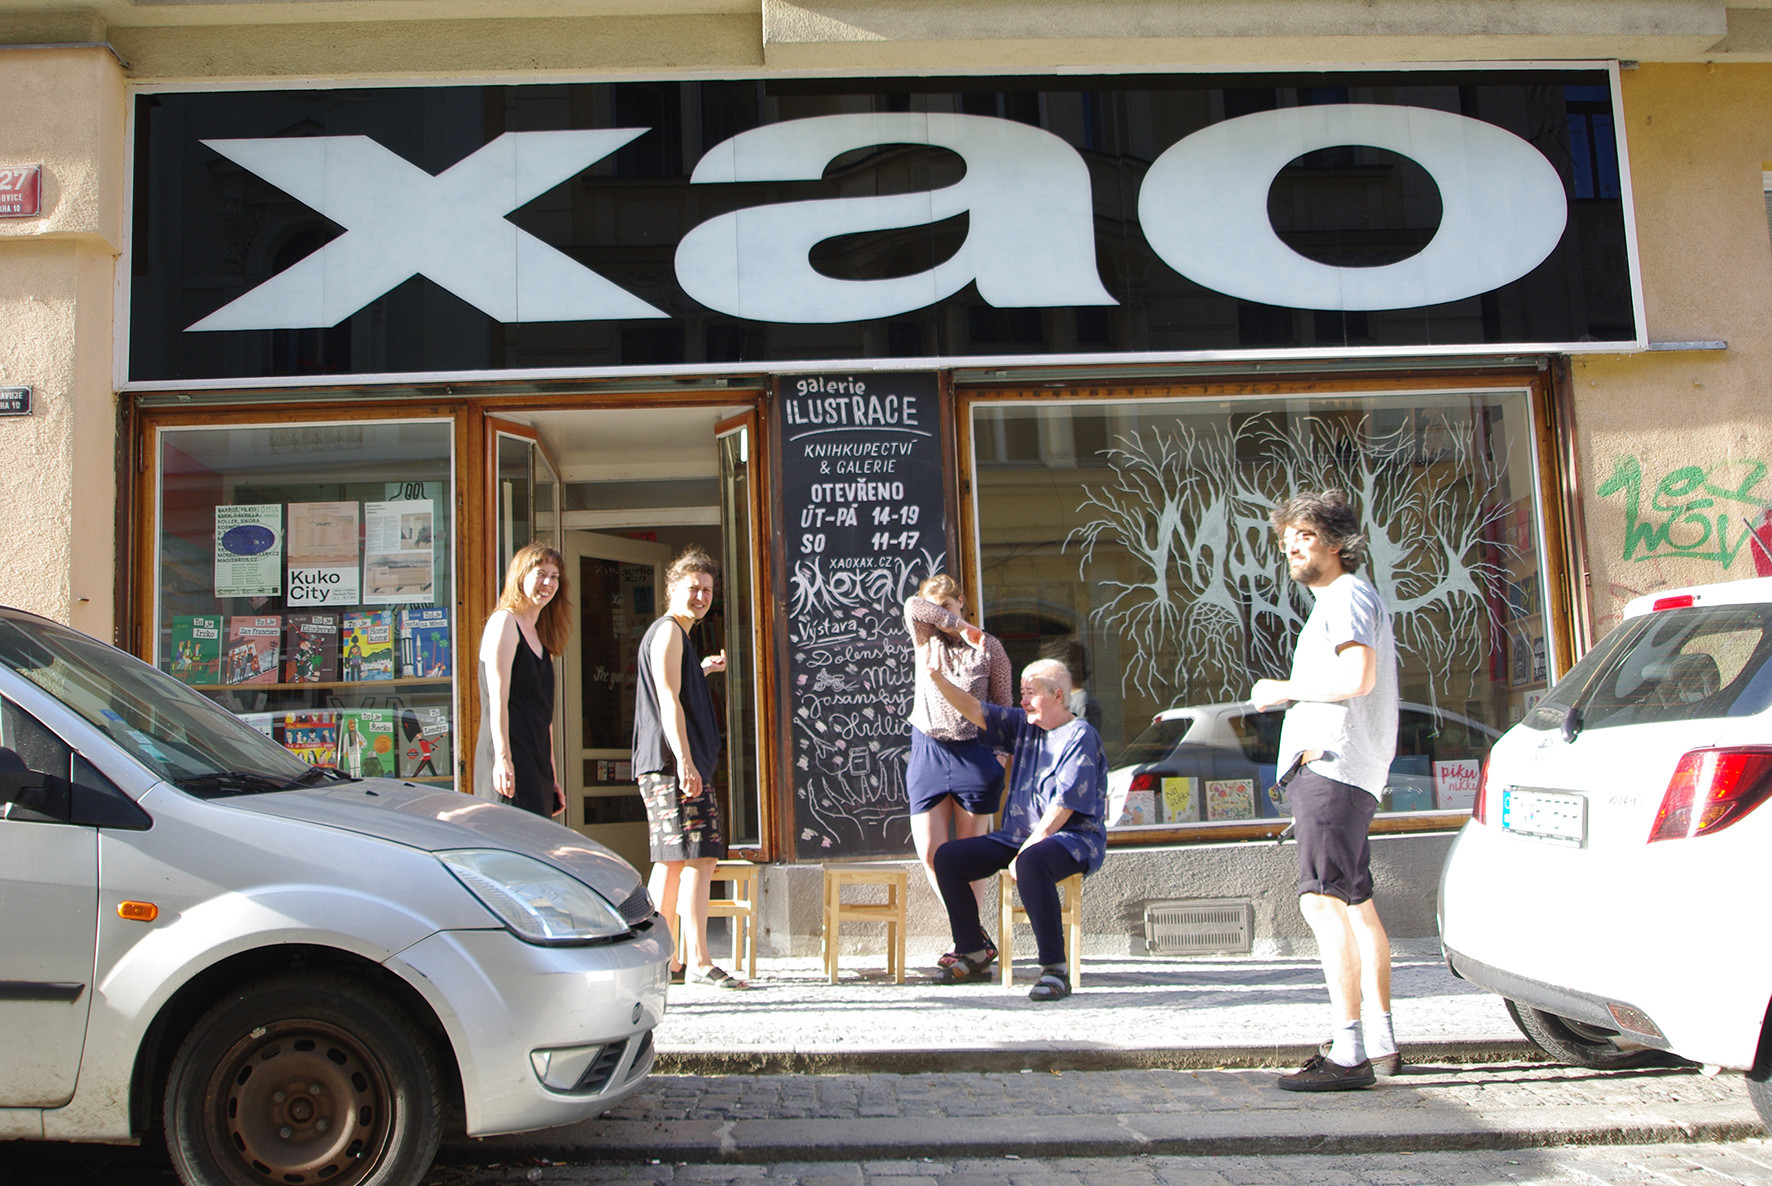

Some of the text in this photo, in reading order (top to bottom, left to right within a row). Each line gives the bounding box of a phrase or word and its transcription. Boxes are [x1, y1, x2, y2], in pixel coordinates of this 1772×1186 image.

[0, 204, 12, 213] HA
[184, 103, 1568, 331] xao
[797, 376, 866, 397] galerie
[786, 395, 919, 426] ILUSTRACE
[804, 439, 919, 459] KNIHKUPECTVÍ
[819, 459, 897, 475] & GALERIE
[810, 477, 905, 503] OTEVŘENO
[800, 503, 920, 528] ÚT-PÁ 14-19
[800, 531, 921, 554] SO 11-17
[829, 556, 893, 569] XAOXAX.CZ
[291, 570, 341, 585] Kuko
[290, 585, 330, 603] City
[798, 617, 858, 645] Výstava
[1441, 764, 1478, 784] piku
